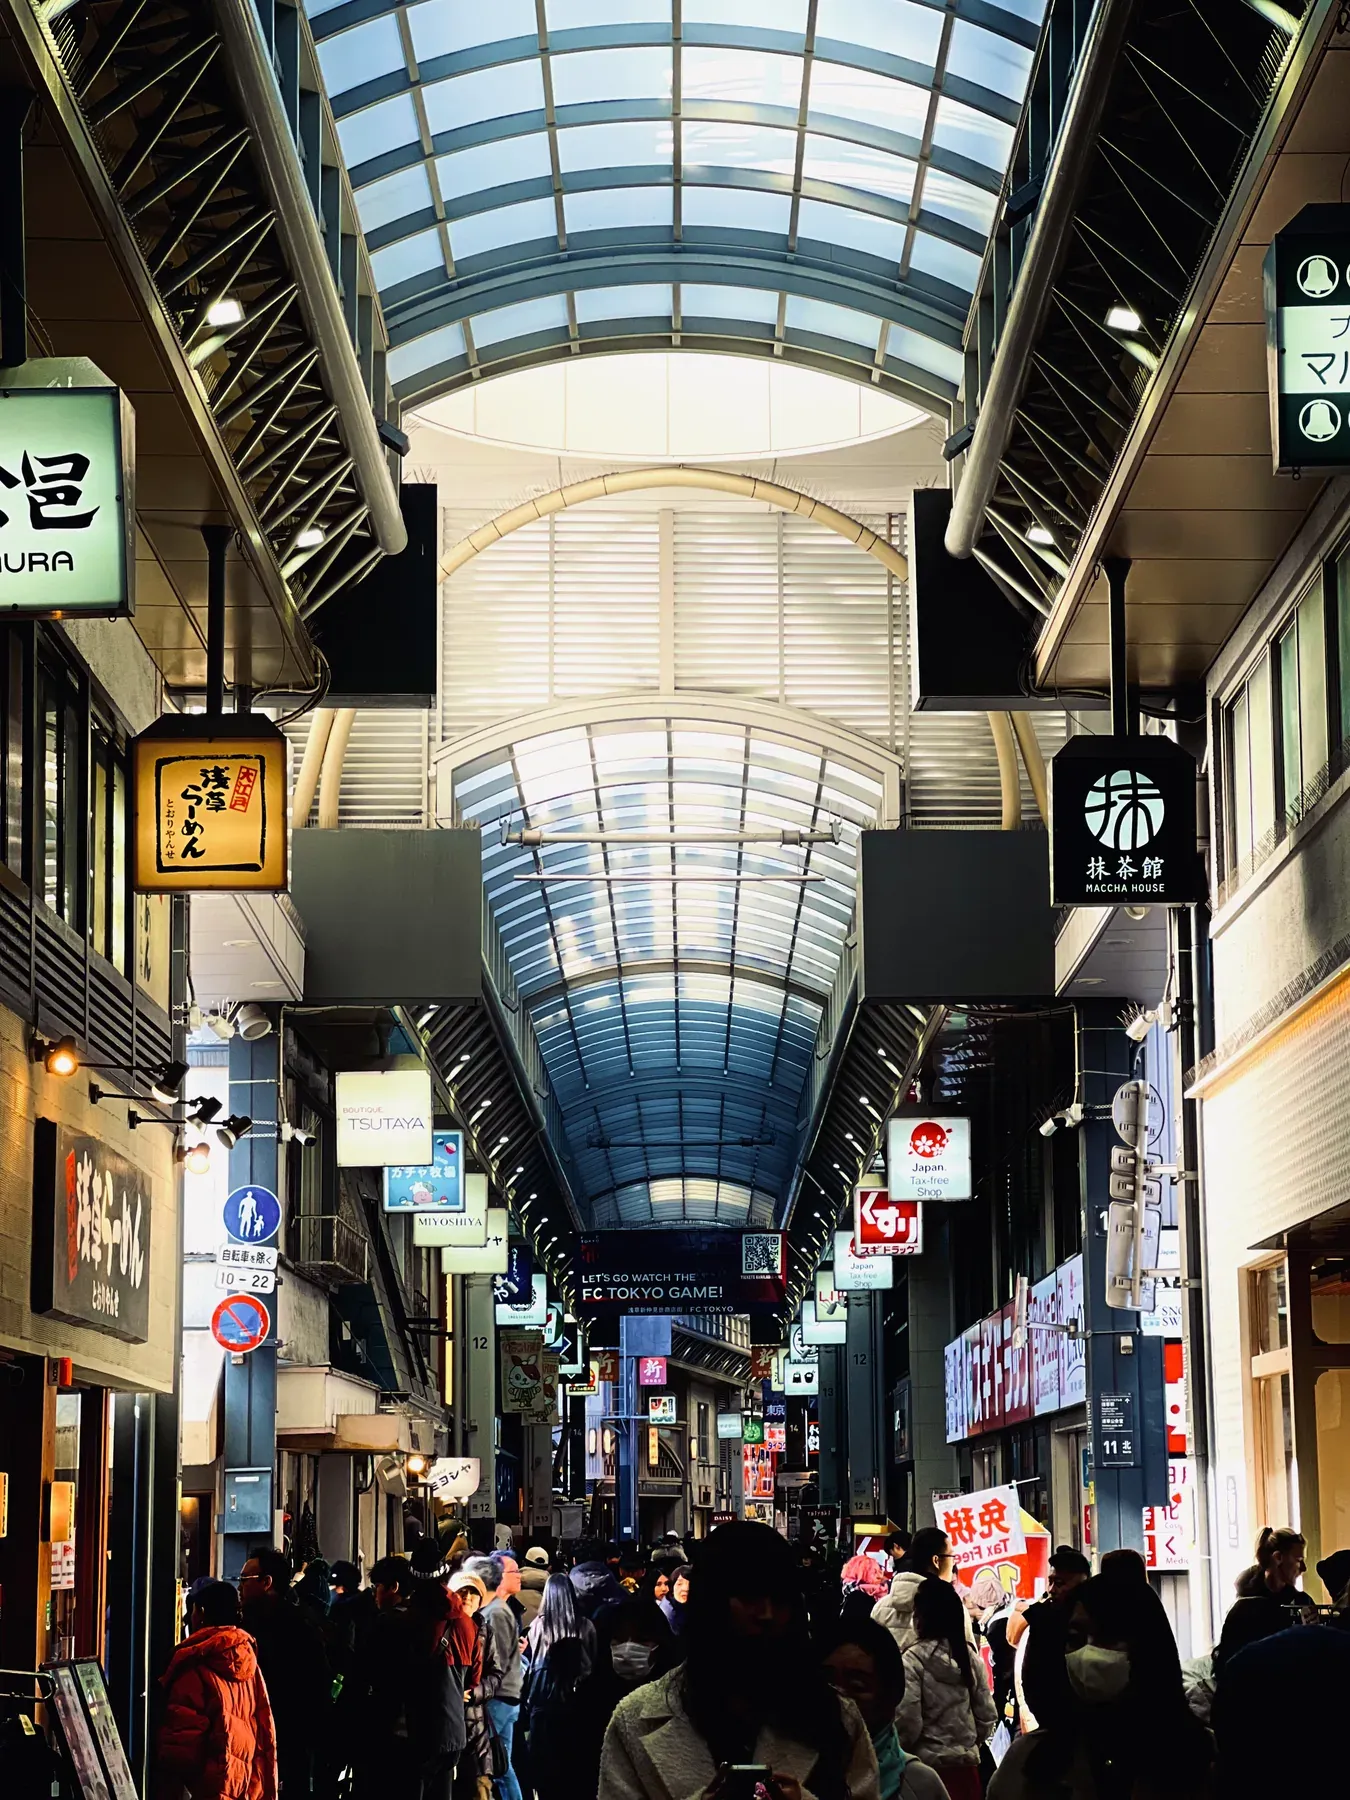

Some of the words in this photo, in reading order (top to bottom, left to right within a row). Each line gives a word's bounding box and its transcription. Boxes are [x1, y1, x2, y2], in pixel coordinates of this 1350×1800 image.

[0, 550, 74, 573] URA
[200, 765, 231, 813] 浅草
[181, 784, 206, 859] らーめん
[165, 799, 175, 859] とおりやんせ
[1086, 855, 1164, 880] 抹茶館
[1086, 883, 1128, 893] MACCHA
[1131, 883, 1165, 893] HOUSE
[348, 1117, 425, 1130] TSUTAYA
[910, 1176, 949, 1185] Tax-free
[917, 1187, 942, 1198] Shop
[418, 1218, 482, 1226] MIYOSHIYA
[861, 1191, 918, 1243] くすり
[861, 1244, 918, 1255] スギドラッグ
[222, 1249, 272, 1265] 自転車を除く
[582, 1273, 610, 1283] LET'S
[612, 1274, 629, 1282] GO
[632, 1273, 671, 1282] WATCH
[674, 1273, 696, 1281] THE
[854, 1280, 873, 1288] Shop
[582, 1287, 603, 1300] FC
[607, 1287, 664, 1299] TOKYO
[668, 1286, 723, 1298] GAME!
[473, 1336, 488, 1349] 12
[853, 1354, 867, 1365] 12
[643, 1359, 662, 1378] 新
[823, 1388, 834, 1397] 13
[1103, 1440, 1117, 1454] 11
[480, 1503, 490, 1512] 12
